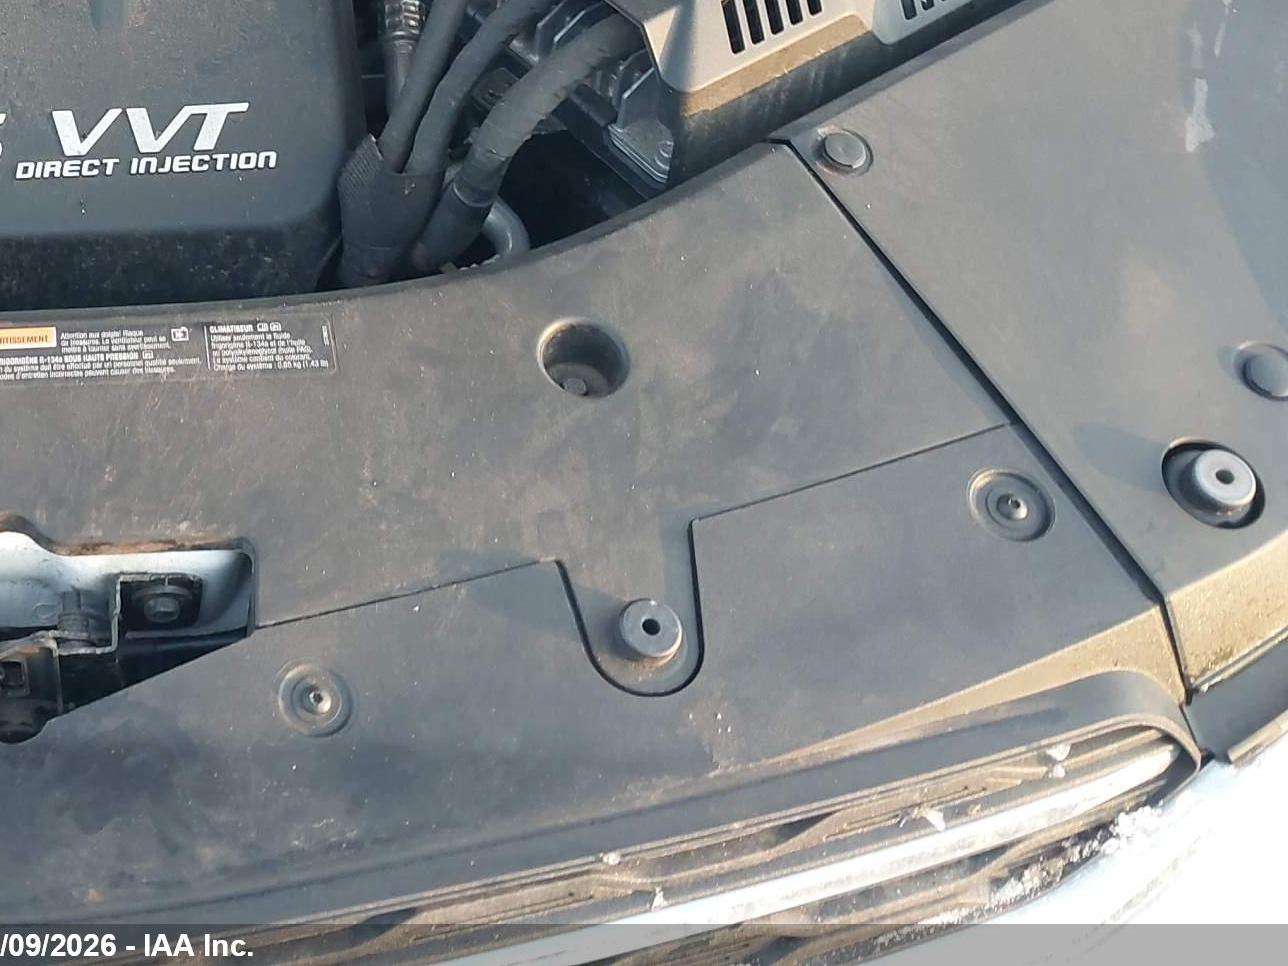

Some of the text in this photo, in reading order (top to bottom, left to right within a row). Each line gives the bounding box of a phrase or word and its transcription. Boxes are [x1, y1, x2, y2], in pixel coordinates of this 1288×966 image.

[51, 102, 249, 157] VVT
[15, 150, 278, 180] DIRECT INJECTION
[210, 324, 253, 333] CLIMATISEUR
